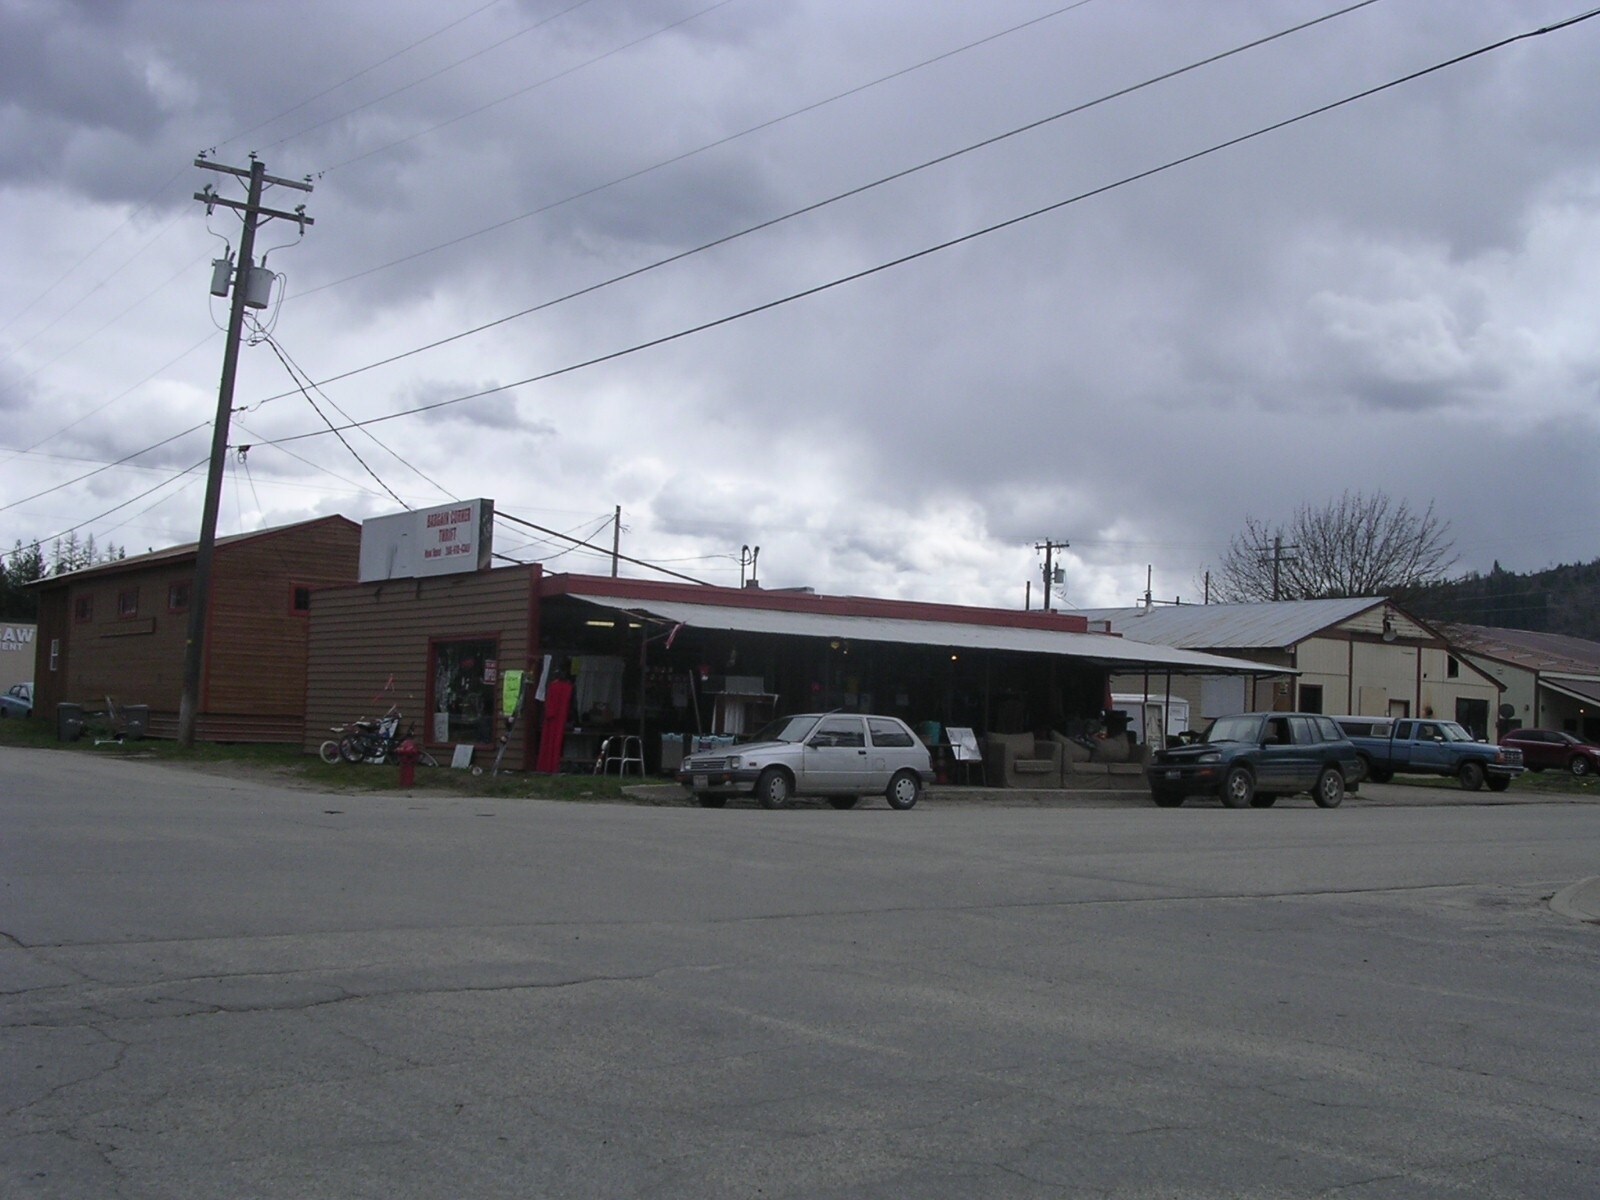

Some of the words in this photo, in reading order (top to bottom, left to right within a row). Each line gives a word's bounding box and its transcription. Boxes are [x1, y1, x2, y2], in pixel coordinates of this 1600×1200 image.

[427, 512, 449, 528] BARGAIN
[450, 508, 471, 524] CORNER
[439, 528, 457, 542] THRIFT
[0, 627, 33, 642] AW
